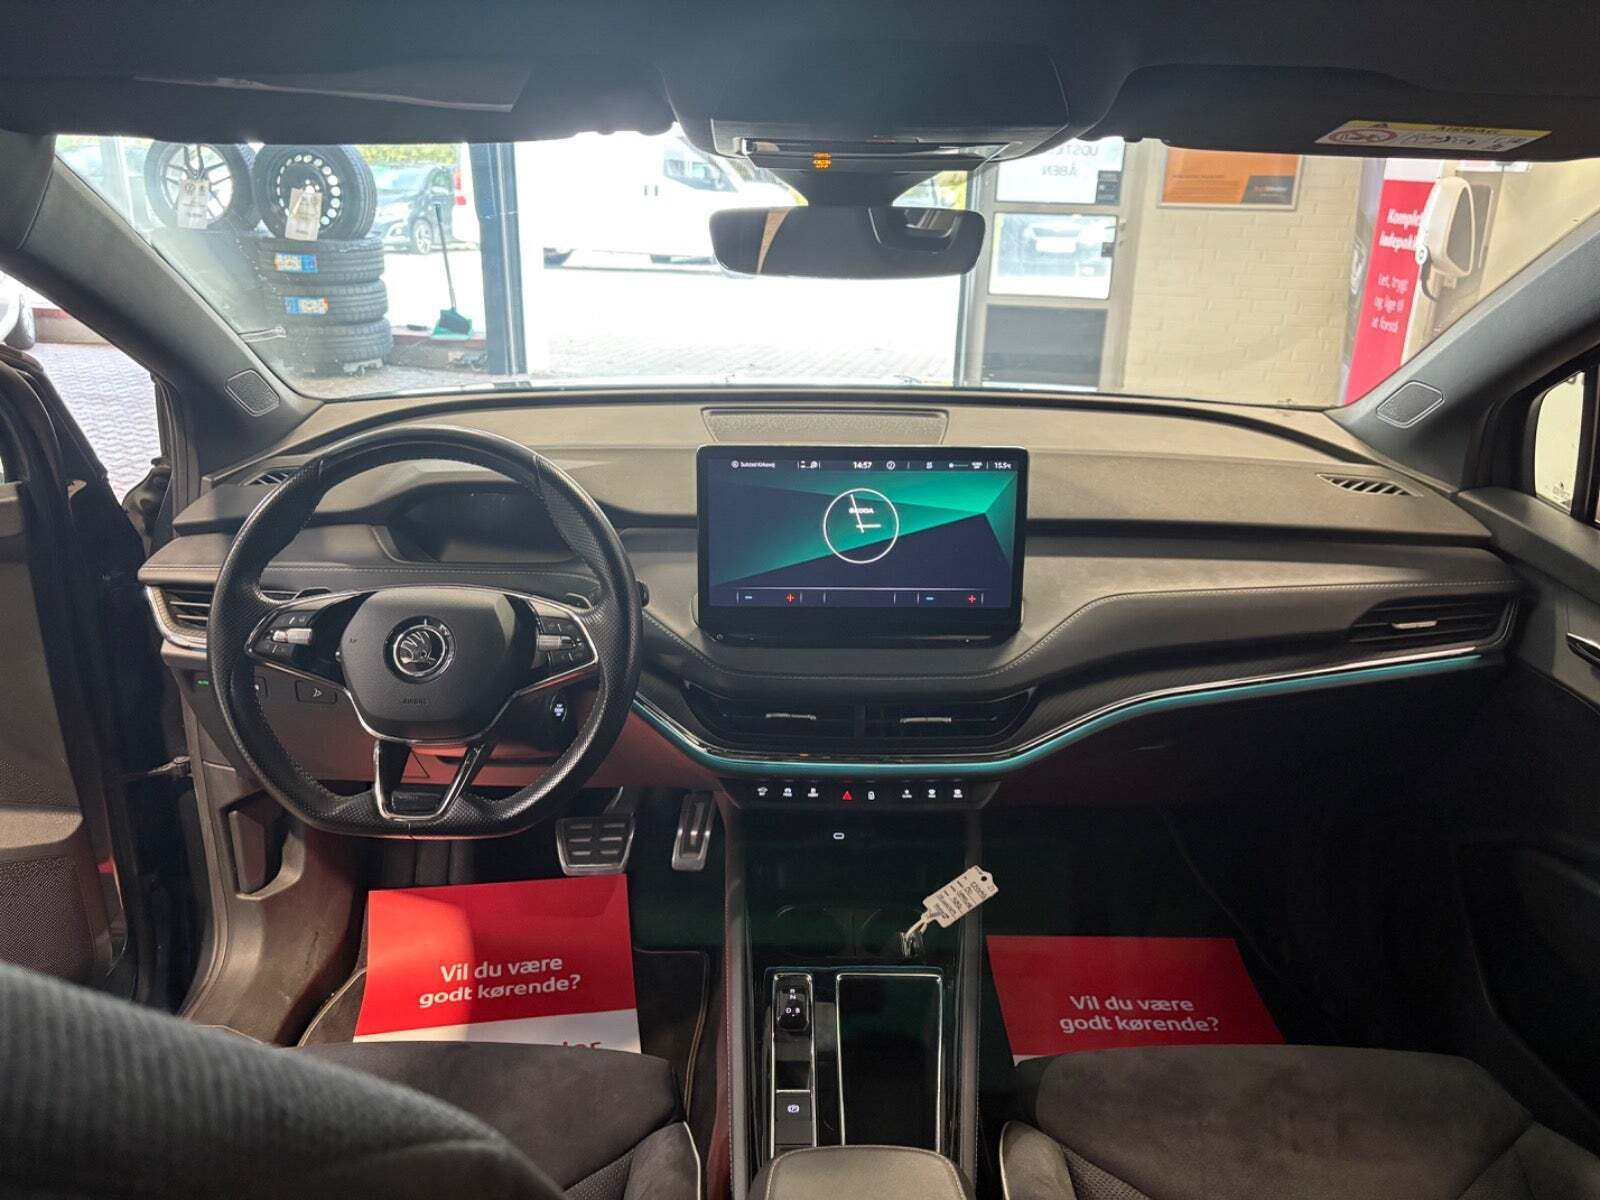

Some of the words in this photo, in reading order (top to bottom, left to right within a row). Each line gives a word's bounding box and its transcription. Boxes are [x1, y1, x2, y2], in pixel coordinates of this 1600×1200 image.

[853, 461, 873, 469] 14:57
[440, 963, 469, 983] Vil
[474, 961, 502, 979] du
[507, 957, 563, 976] være
[419, 986, 473, 1009] godt
[477, 974, 582, 999] kørende?
[1069, 995, 1100, 1011] Vil
[1104, 995, 1134, 1011] du
[1137, 999, 1194, 1012] være
[1059, 1015, 1112, 1034] godt
[1115, 1015, 1219, 1032] kørende?
